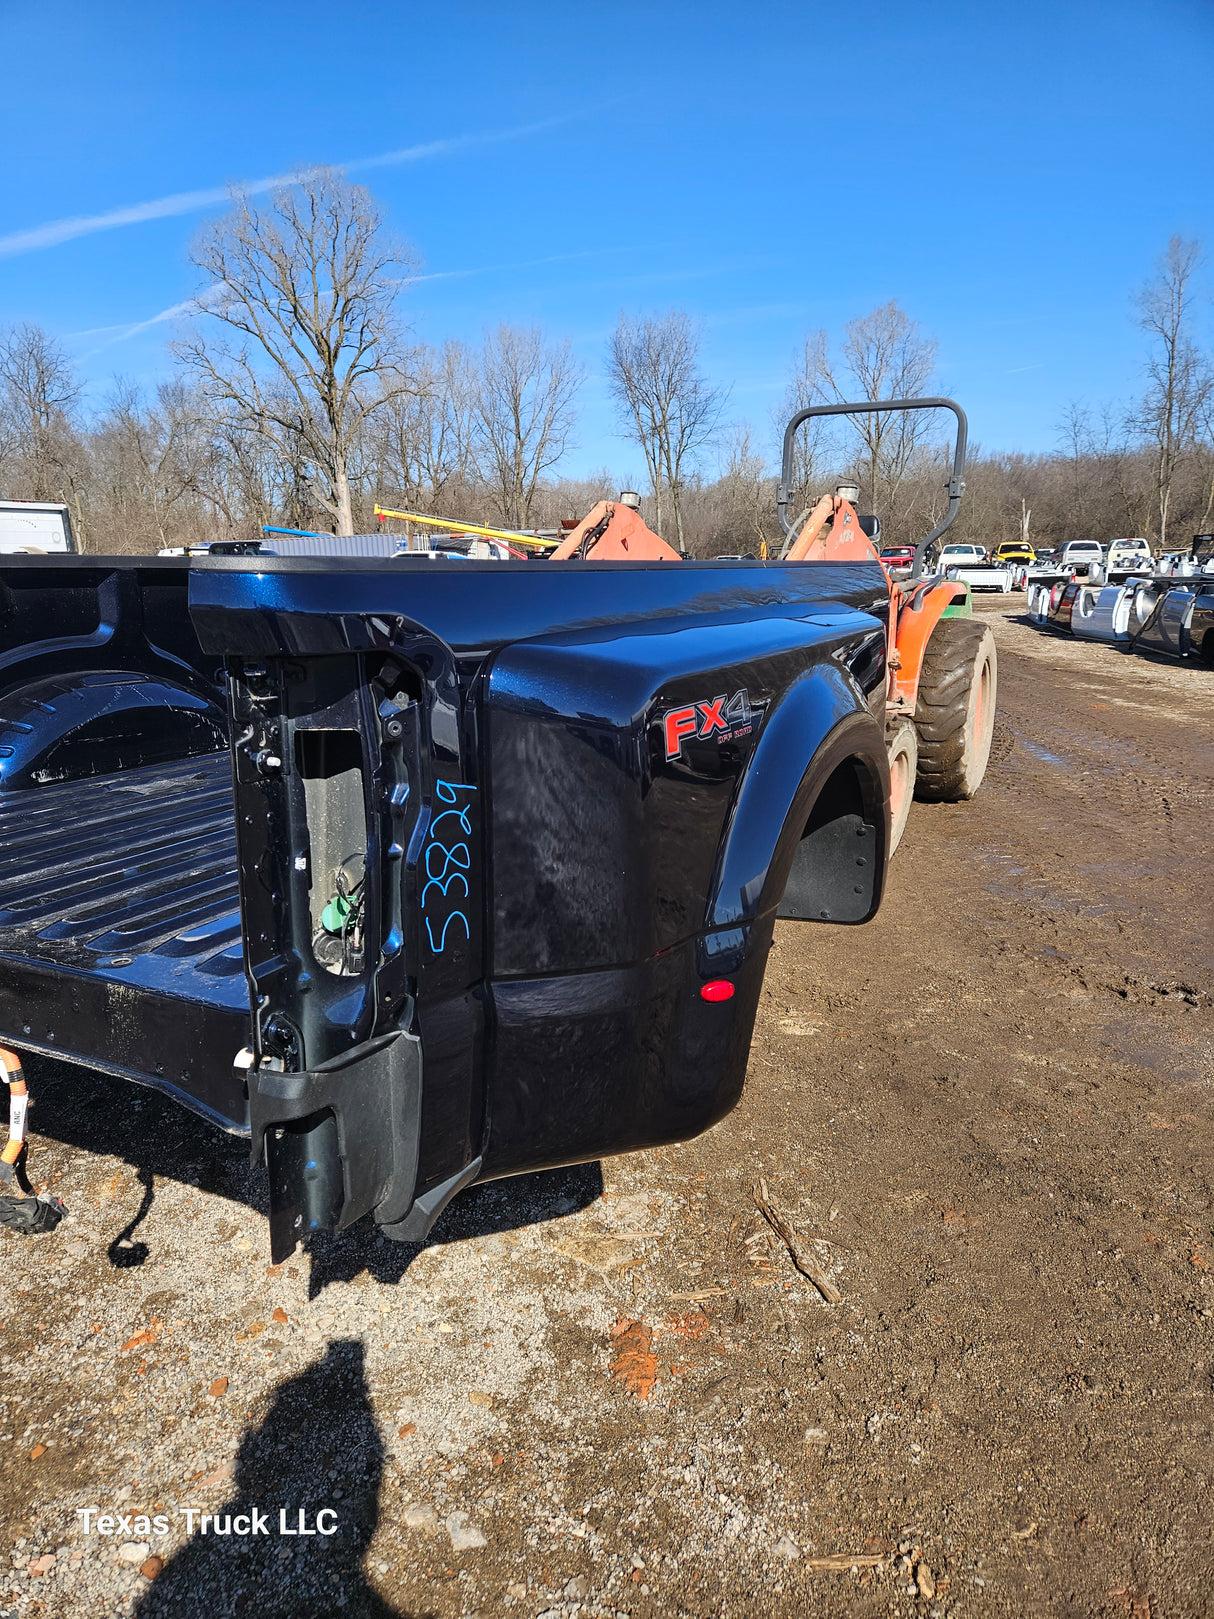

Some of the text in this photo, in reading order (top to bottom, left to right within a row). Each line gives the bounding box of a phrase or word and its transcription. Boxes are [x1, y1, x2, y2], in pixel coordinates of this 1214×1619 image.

[663, 688, 752, 762] FX4
[718, 732, 732, 744] OFF
[420, 779, 478, 952] 53829
